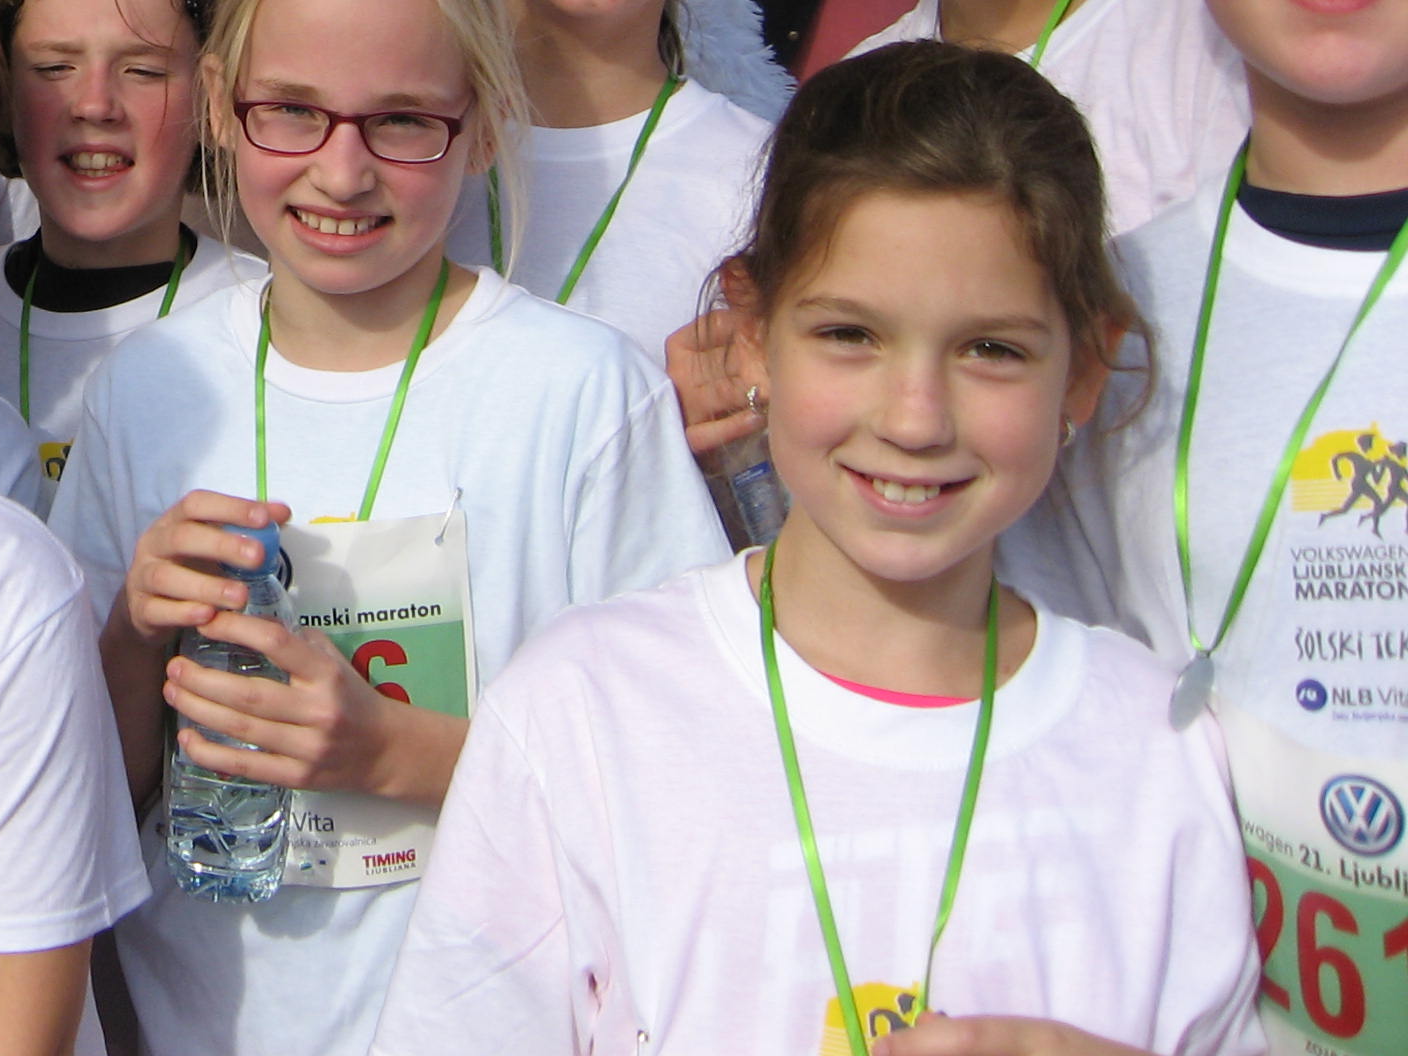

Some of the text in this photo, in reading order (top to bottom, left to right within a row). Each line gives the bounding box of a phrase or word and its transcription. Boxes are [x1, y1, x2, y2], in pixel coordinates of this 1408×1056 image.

[1293, 563, 1407, 580] LJUBLJANSK
[1295, 581, 1408, 601] MARATON
[299, 603, 442, 627] anski maraton
[1332, 687, 1372, 705] NLB
[292, 811, 334, 832] Vita
[363, 848, 417, 869] TIMING
[1245, 821, 1408, 897] wagen 21. Ljublj
